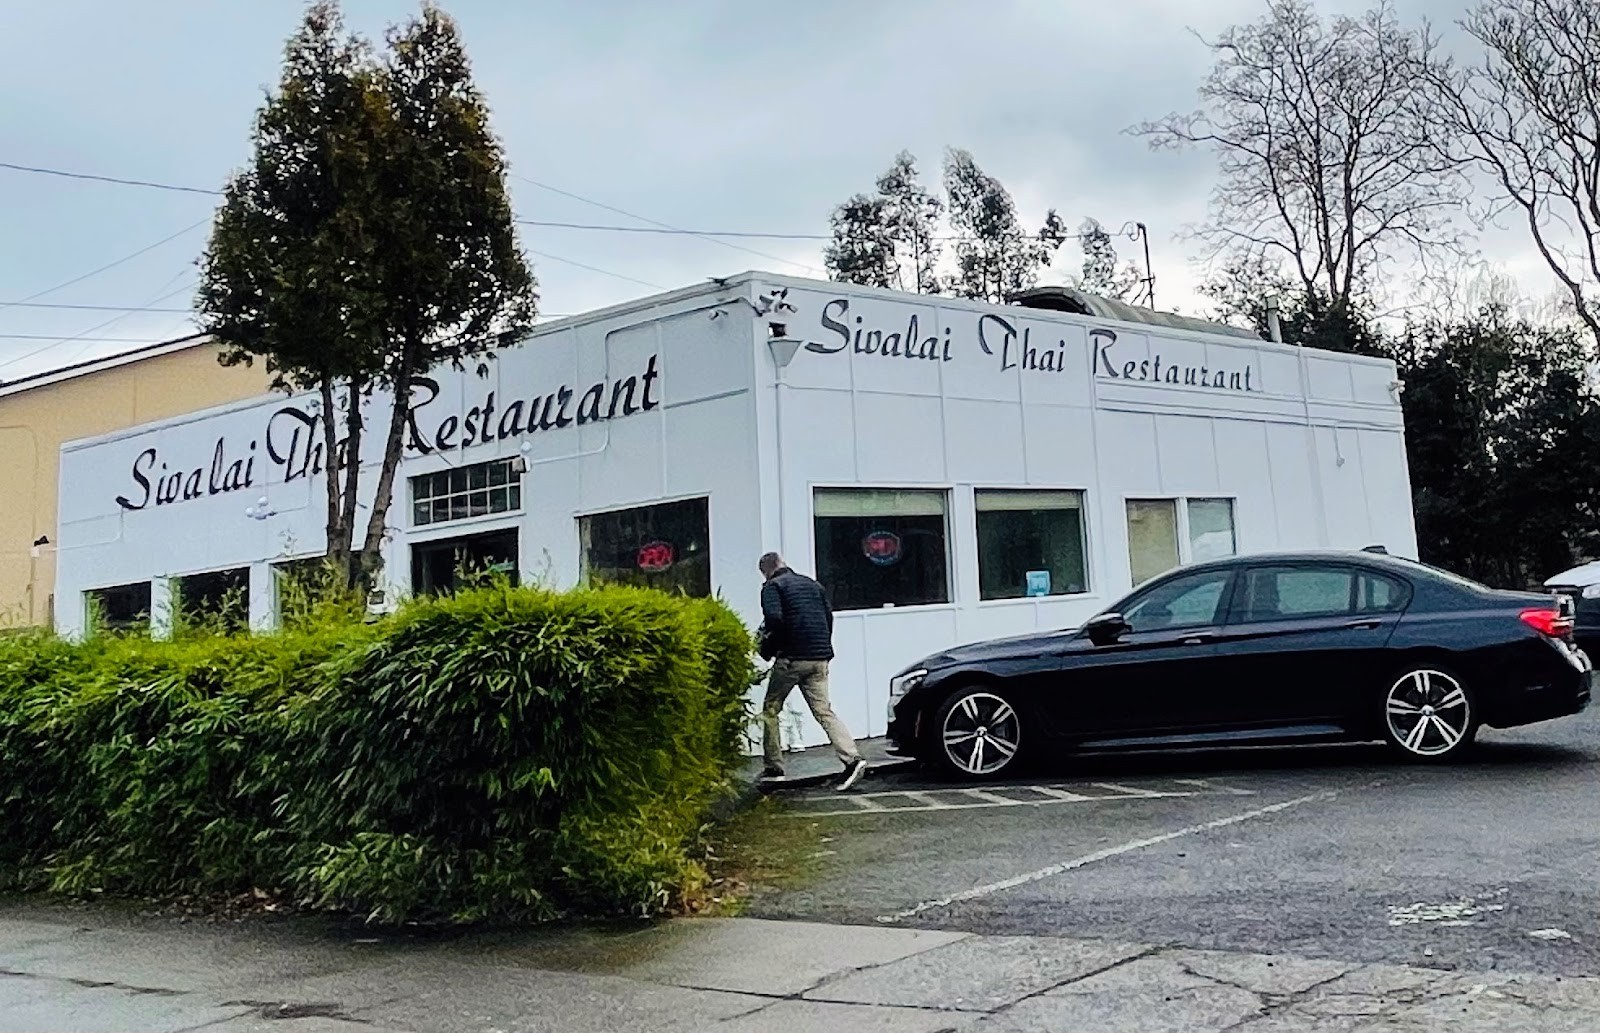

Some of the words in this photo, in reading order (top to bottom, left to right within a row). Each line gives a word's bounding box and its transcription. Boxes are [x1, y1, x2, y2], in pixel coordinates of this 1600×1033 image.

[805, 298, 952, 362] Sivalai
[979, 313, 1066, 373] Thai
[1091, 329, 1254, 392] Restaurant
[115, 435, 260, 511] Sivalai
[266, 406, 363, 483] Tha
[400, 354, 660, 456] Restaurant
